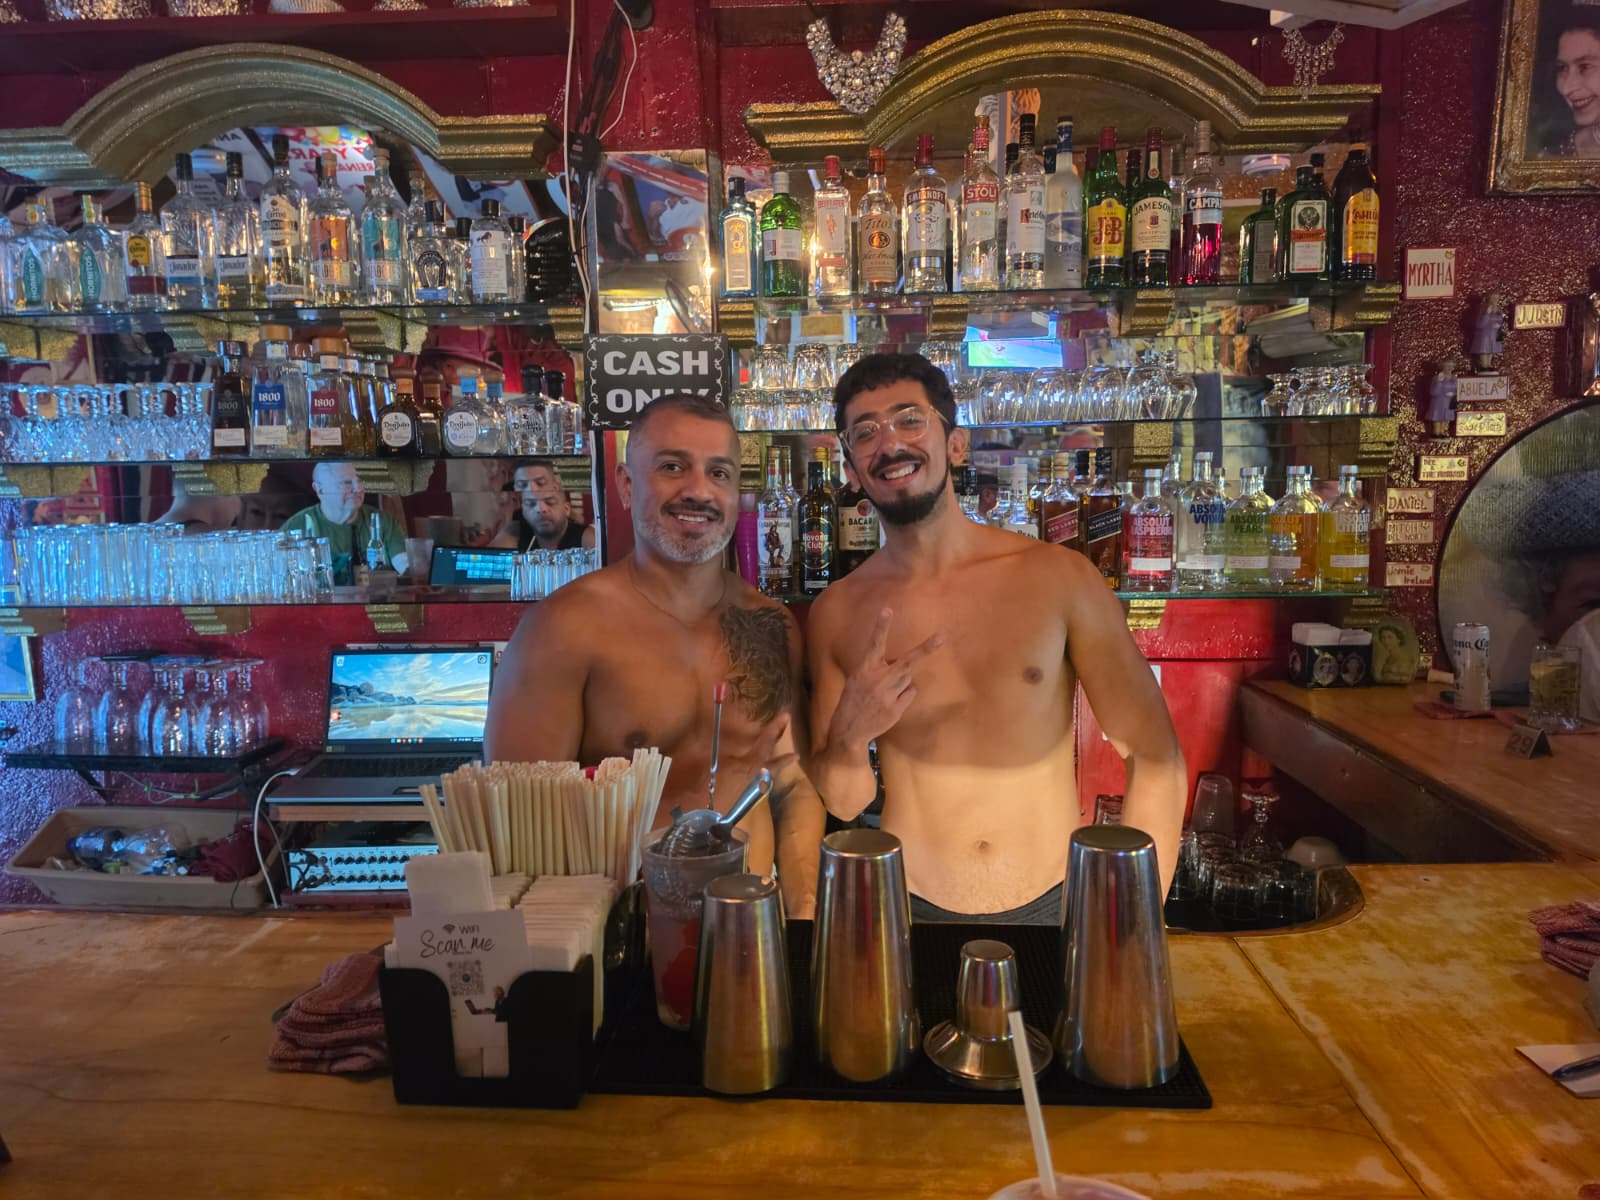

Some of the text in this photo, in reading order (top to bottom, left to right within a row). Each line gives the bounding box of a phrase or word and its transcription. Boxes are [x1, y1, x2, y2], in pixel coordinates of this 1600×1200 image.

[1134, 201, 1172, 216] JAMESON
[1092, 217, 1123, 246] J&B
[1408, 262, 1453, 288] MYRTHA
[603, 350, 709, 376] CASH
[257, 392, 281, 402] 1800
[1460, 382, 1498, 396] ABUELA
[313, 397, 335, 408] 1800
[606, 388, 710, 413] ON
[807, 541, 823, 549] Club
[420, 929, 465, 958] Scan
